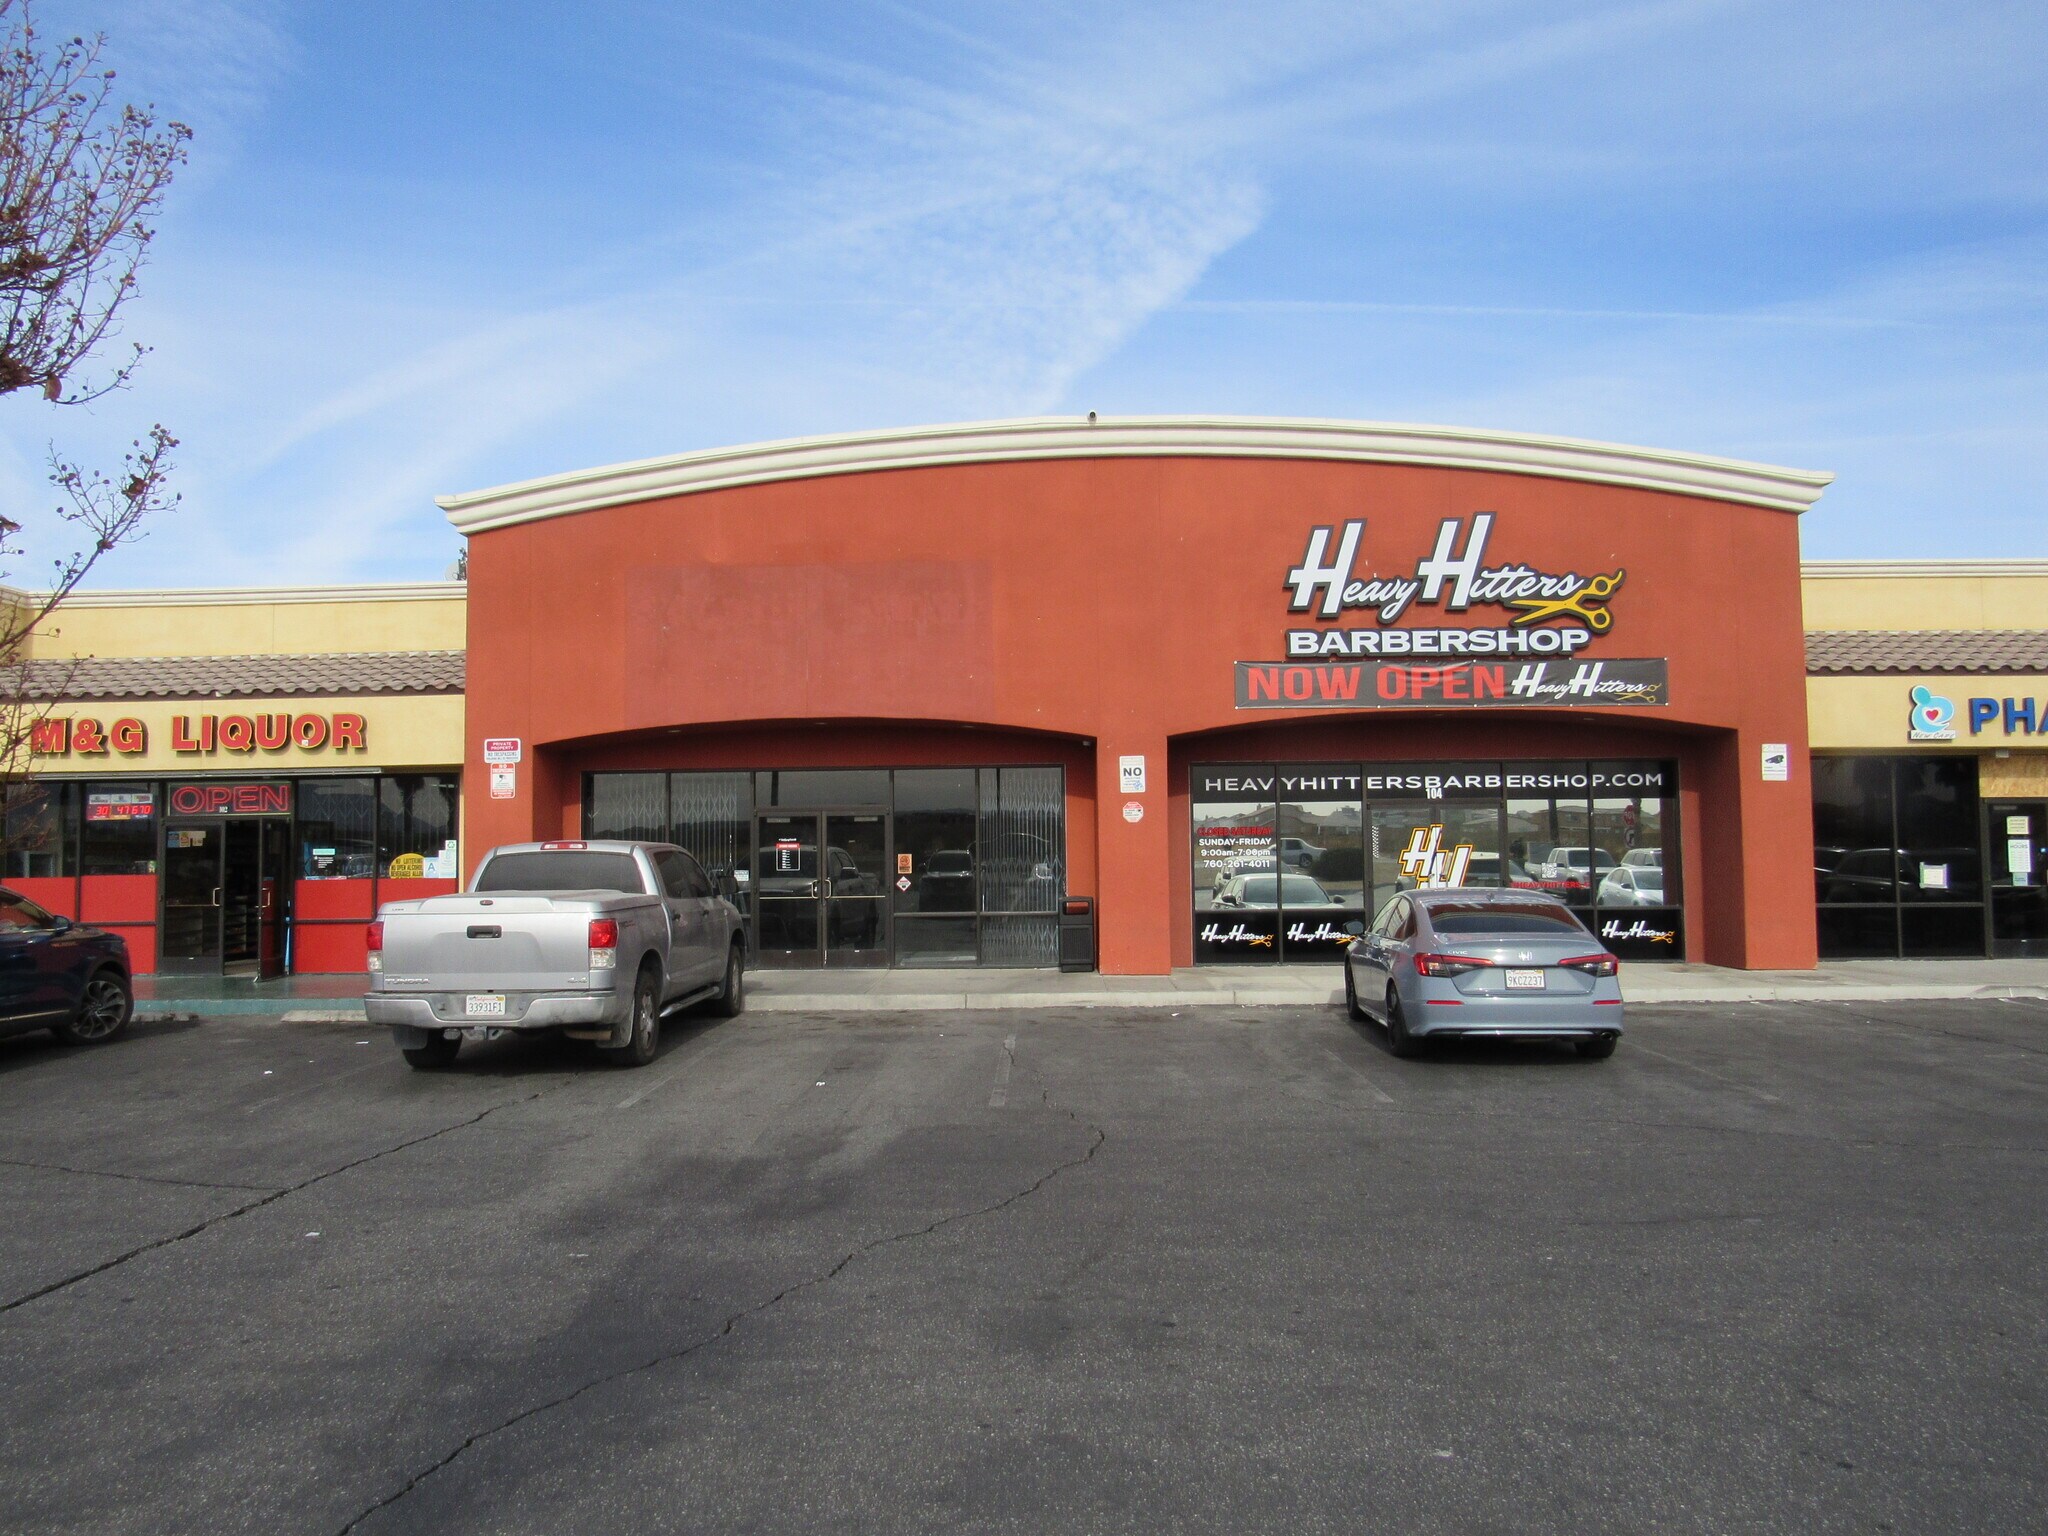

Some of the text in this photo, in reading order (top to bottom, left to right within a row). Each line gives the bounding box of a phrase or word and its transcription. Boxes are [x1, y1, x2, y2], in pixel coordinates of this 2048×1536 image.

[1288, 514, 1585, 620] Heavy Hitters
[1288, 629, 1590, 654] BARBERSHOP
[1248, 662, 1648, 700] NOW OPEN Heavy Hitters
[1968, 697, 2048, 734] PH
[31, 712, 364, 753] M&G LIQUOR
[1123, 767, 1142, 777] NO
[1205, 773, 1662, 791] HEAVYHITTERSBARBERSHOP.COM
[172, 785, 288, 814] OPEN
[1425, 788, 1443, 799] 104
[1197, 825, 1273, 837] CLOSED SATURDAY
[1198, 838, 1272, 846] SUNDAY-FRIDAY
[1200, 848, 1271, 858] 9:00am-7:00pm
[427, 862, 436, 871] A
[1203, 860, 1271, 868] 760-261-4011
[1200, 923, 1266, 943] Heavy Hitters
[1287, 922, 1316, 942] Heavy
[1601, 919, 1666, 940] Heavy Hitters
[1507, 975, 1543, 986] 9KCZ237
[468, 1002, 503, 1013] 33931F1
